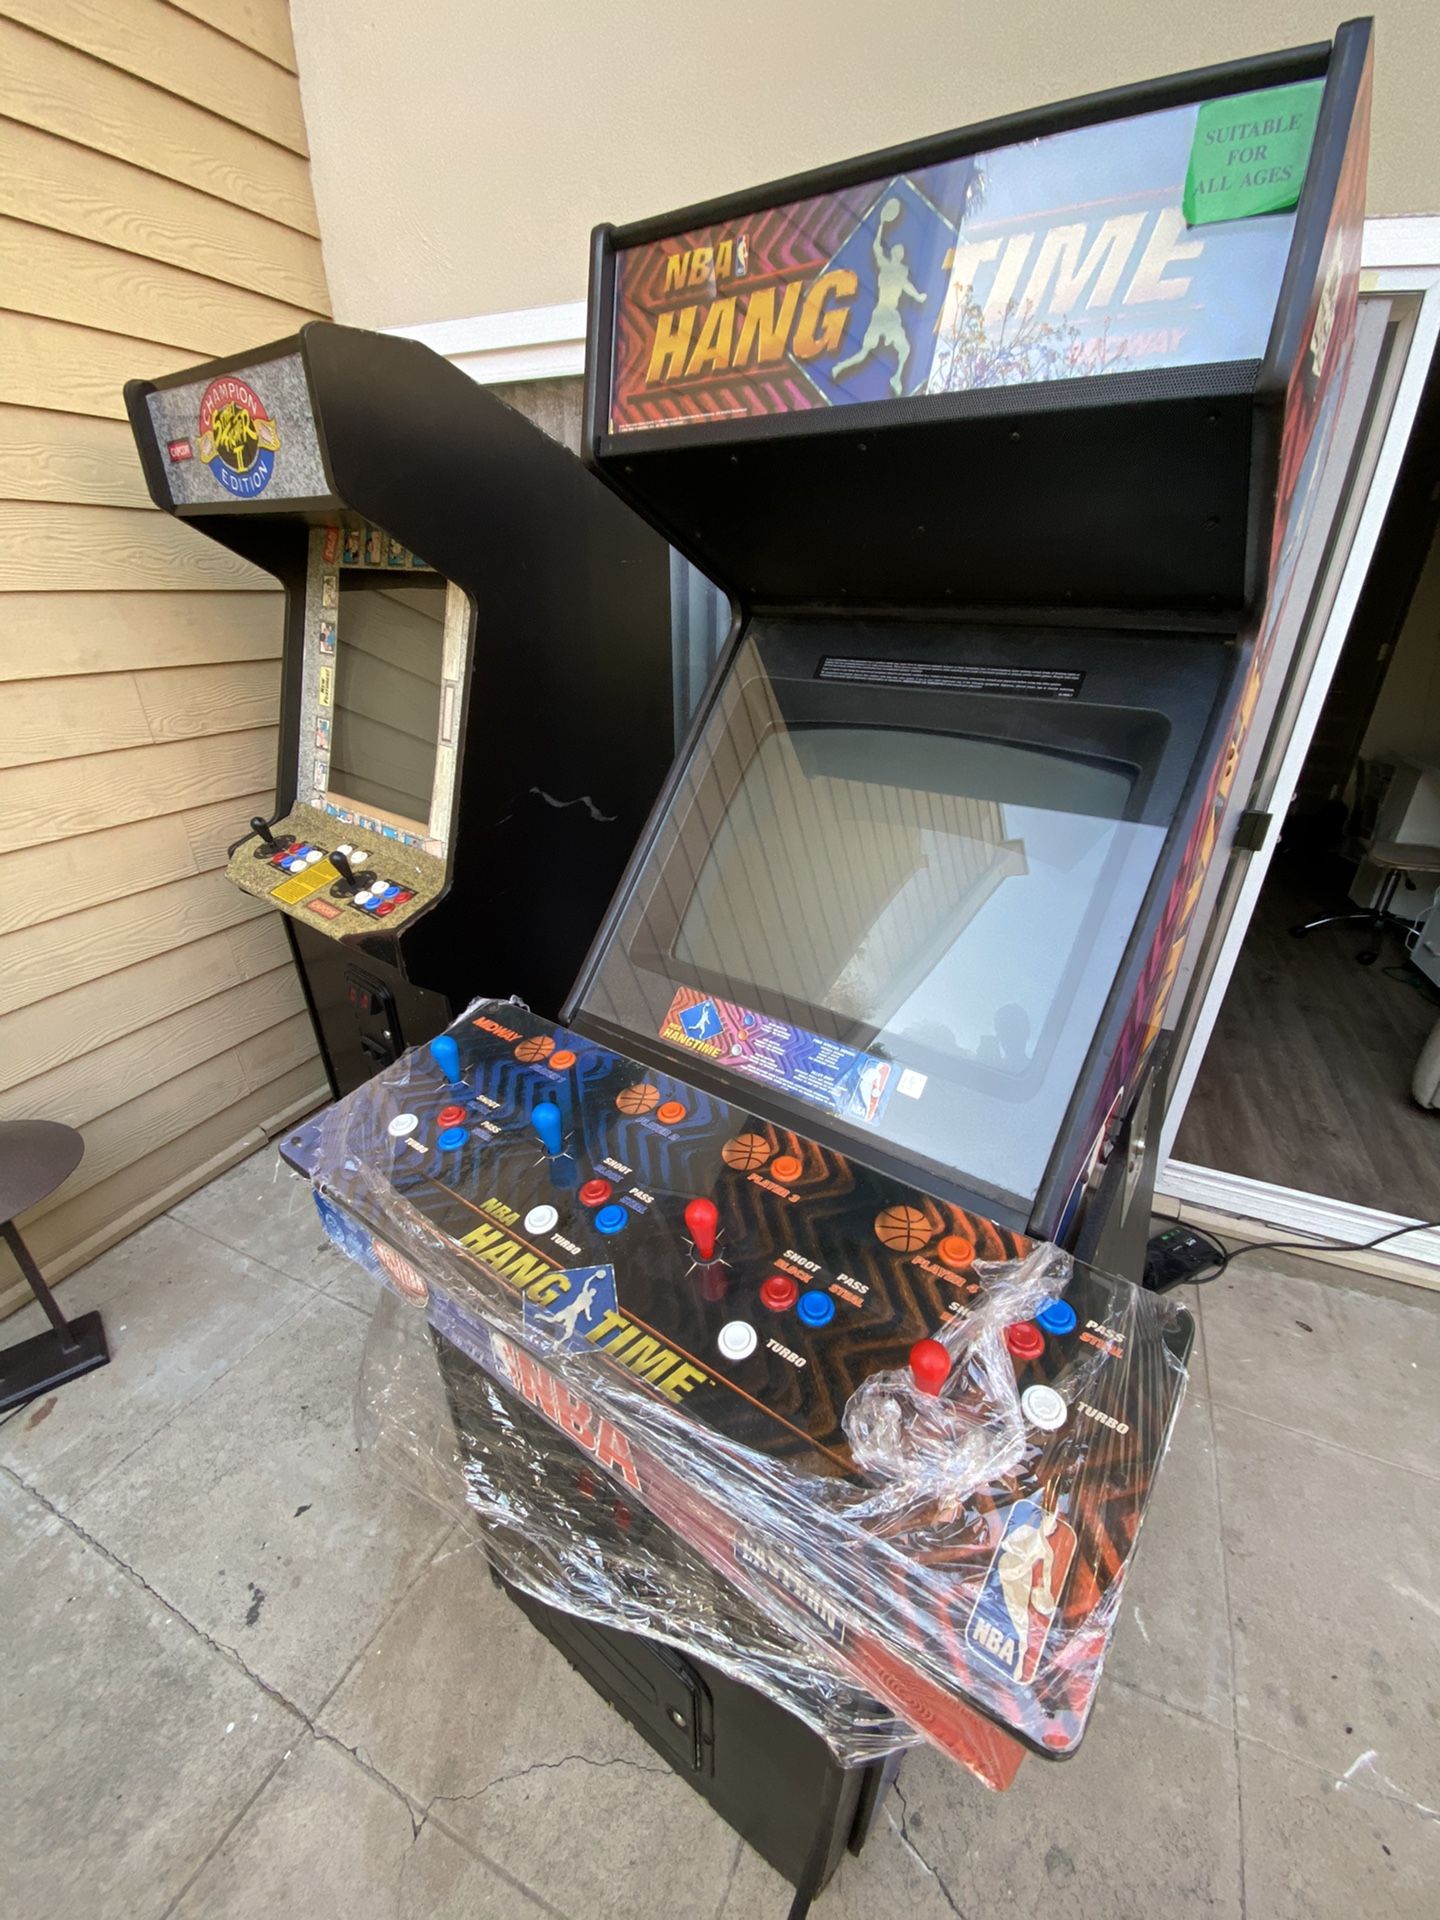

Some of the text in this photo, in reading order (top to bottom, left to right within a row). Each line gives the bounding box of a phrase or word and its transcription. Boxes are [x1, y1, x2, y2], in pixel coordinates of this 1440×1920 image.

[1204, 113, 1303, 146] SUITABLE
[1226, 144, 1268, 167] FOR
[1193, 164, 1293, 196] ALL AGES
[664, 239, 733, 293] NBA
[645, 206, 1205, 384] HANG TIME
[202, 382, 258, 426] CHAMPION
[221, 460, 268, 493] EDITION
[472, 1016, 523, 1042] MIDWAY
[662, 1027, 722, 1058] HANGTIME
[602, 1156, 633, 1175] SHOOT
[628, 1186, 655, 1204] PASS
[479, 1197, 521, 1227] NBA
[549, 1232, 582, 1256] TURBO
[783, 1249, 822, 1273] SHOOT
[911, 1255, 967, 1288] PLAYER
[836, 1273, 870, 1294] PASS
[457, 1222, 572, 1306] HANG
[584, 1309, 709, 1404] TIME
[1085, 1319, 1126, 1343] PASS
[765, 1337, 807, 1369] TURBO
[515, 1347, 642, 1493] NBA
[1077, 1401, 1130, 1435] TURBO
[972, 1616, 1015, 1667] NBA
